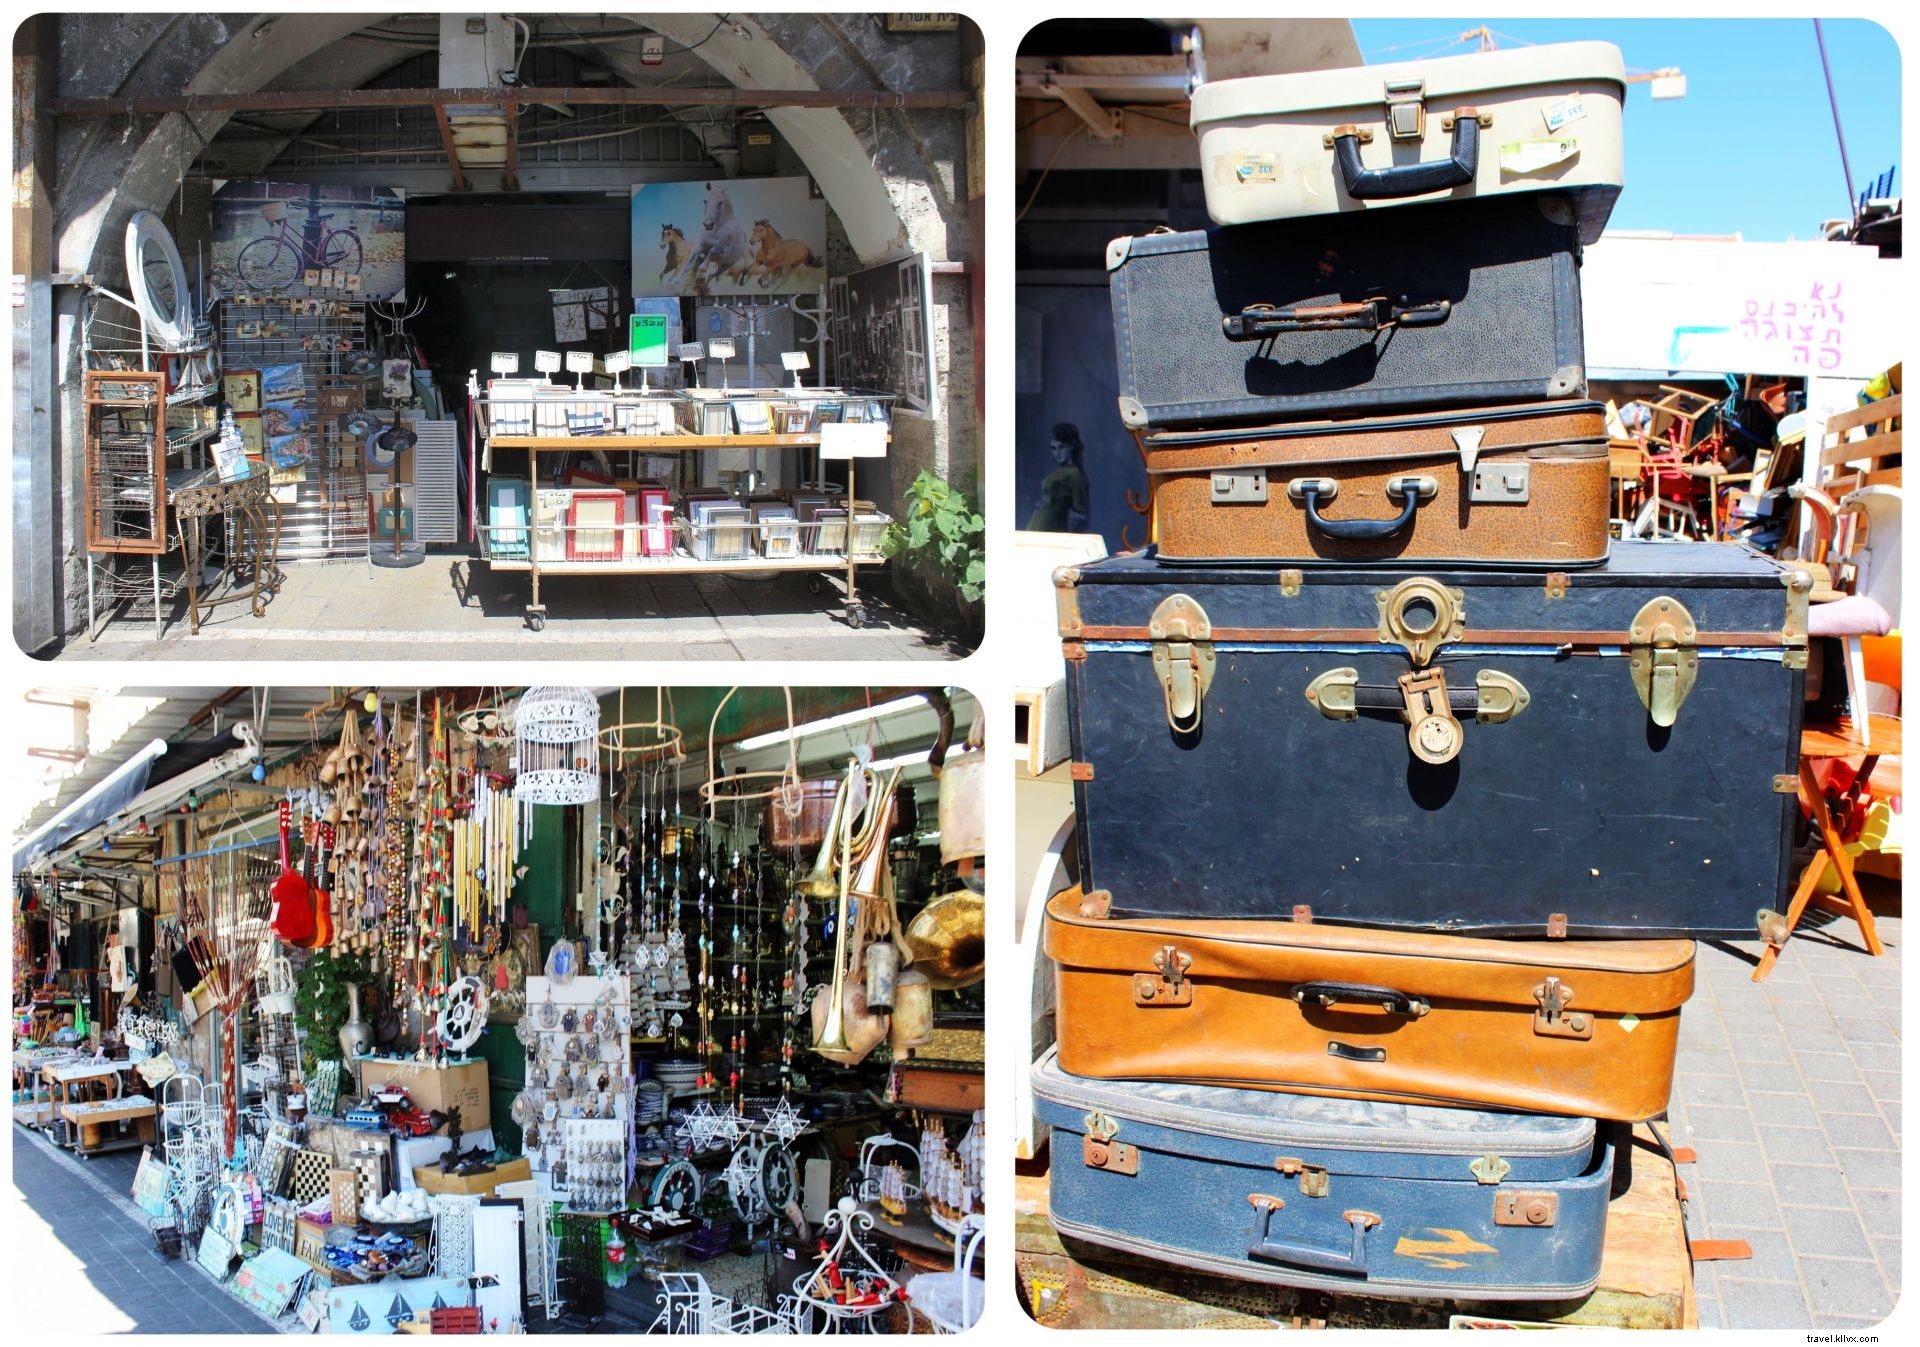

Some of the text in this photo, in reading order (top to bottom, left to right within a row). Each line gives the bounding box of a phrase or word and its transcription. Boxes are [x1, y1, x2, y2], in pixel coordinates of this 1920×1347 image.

[1810, 281, 1842, 301] נא
[1740, 319, 1841, 344] תצוגה
[1792, 345, 1842, 370] פה
[264, 1208, 282, 1233] LOVE
